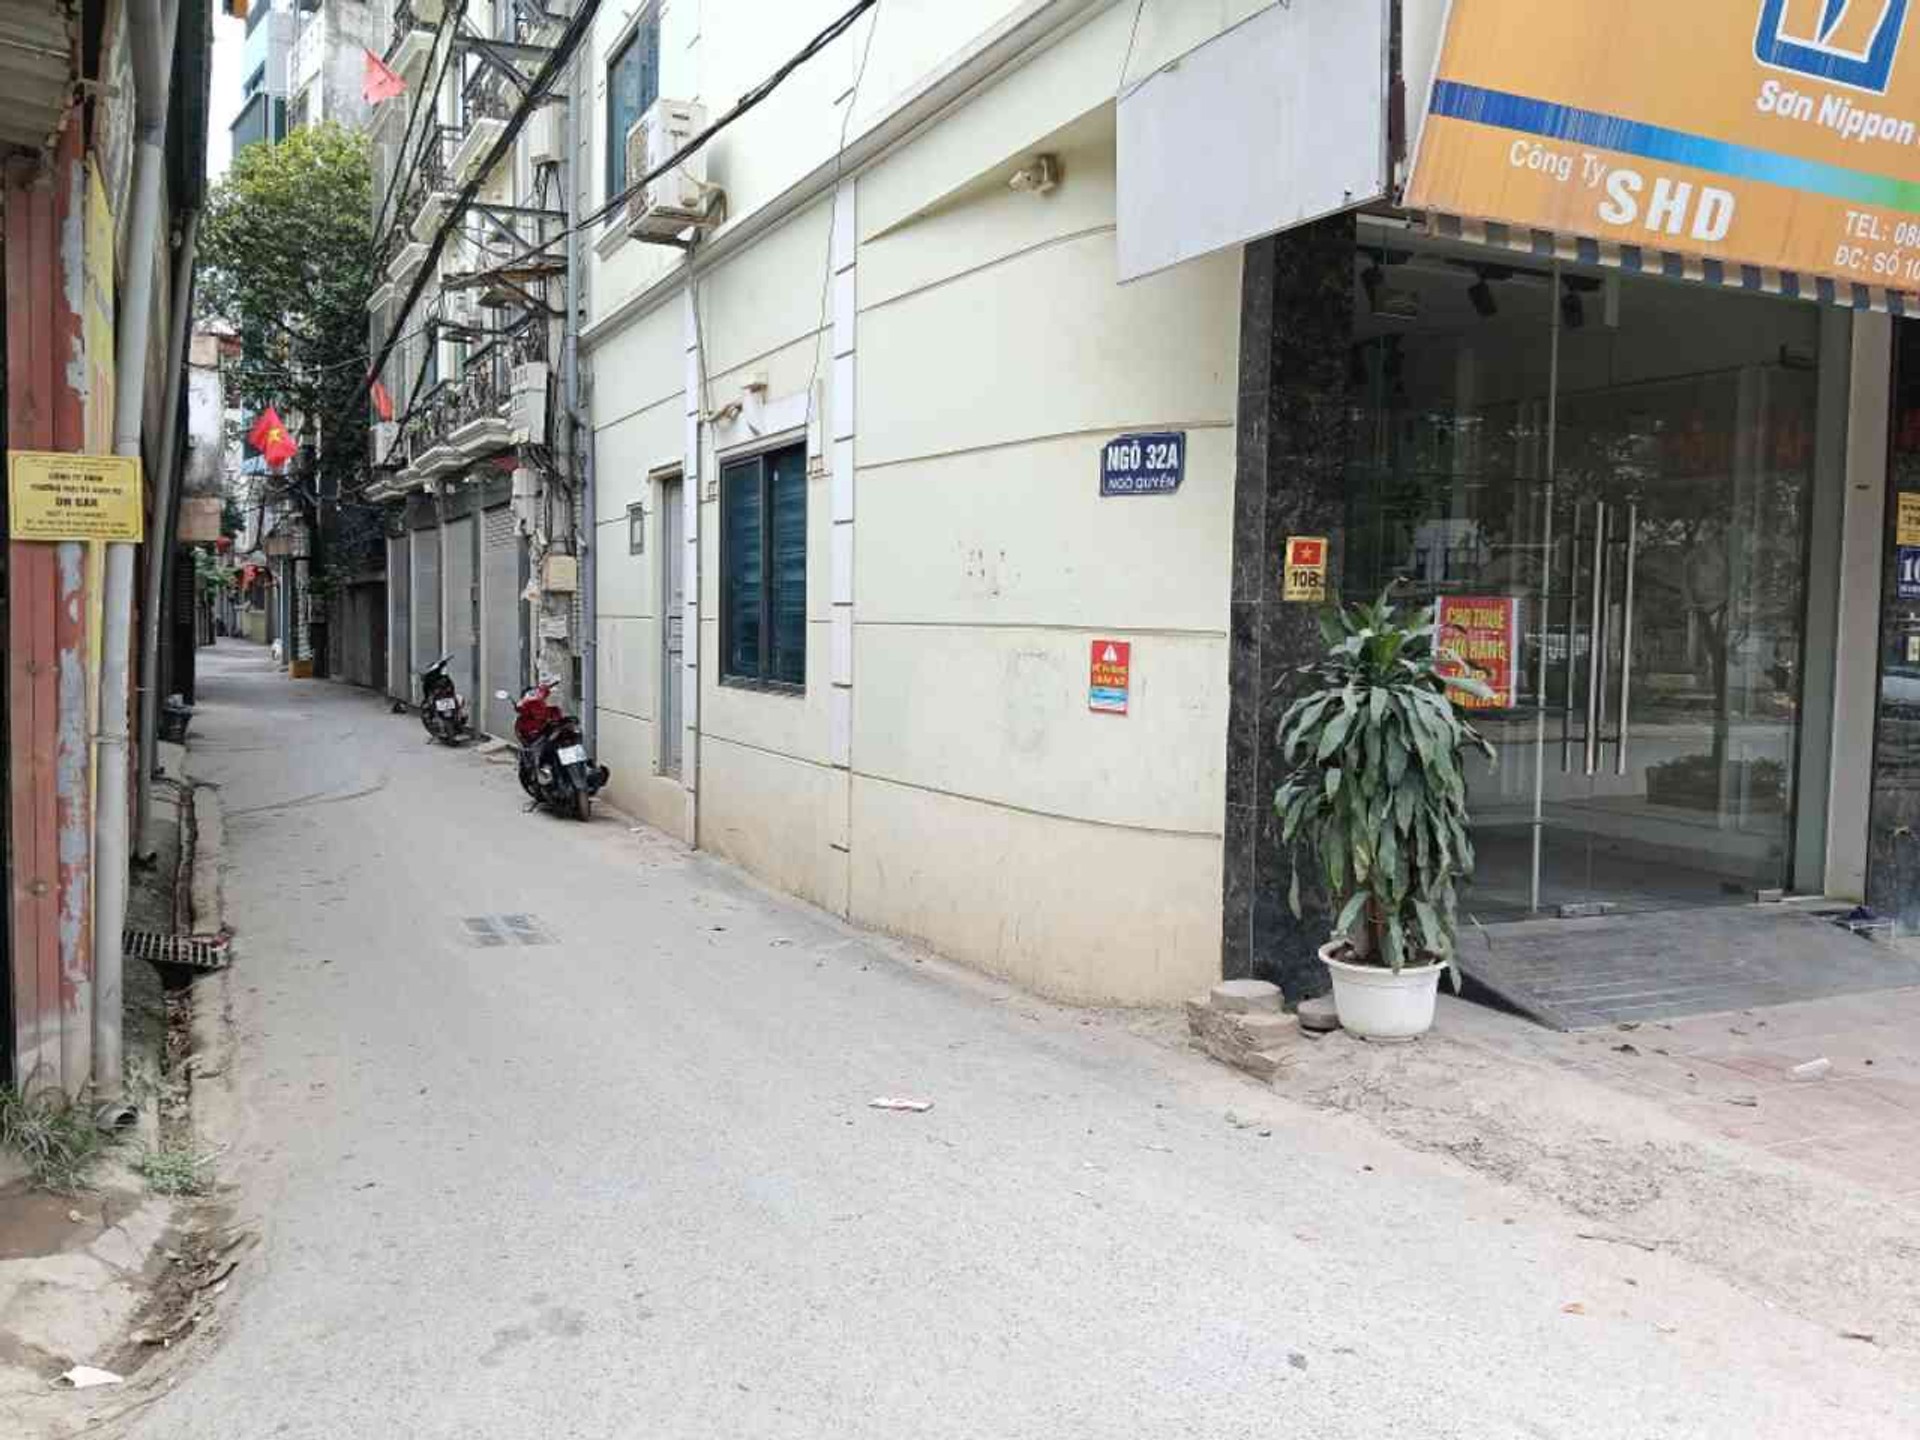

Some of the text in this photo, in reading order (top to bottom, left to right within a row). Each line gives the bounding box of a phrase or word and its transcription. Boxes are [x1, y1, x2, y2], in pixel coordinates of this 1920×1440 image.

[1755, 79, 1917, 146] Sơn Nippon
[1509, 140, 1736, 243] Công Ty SHD
[1846, 210, 1889, 242] TEL:
[1834, 243, 1869, 271] ĐC:
[1145, 442, 1179, 471] 32A
